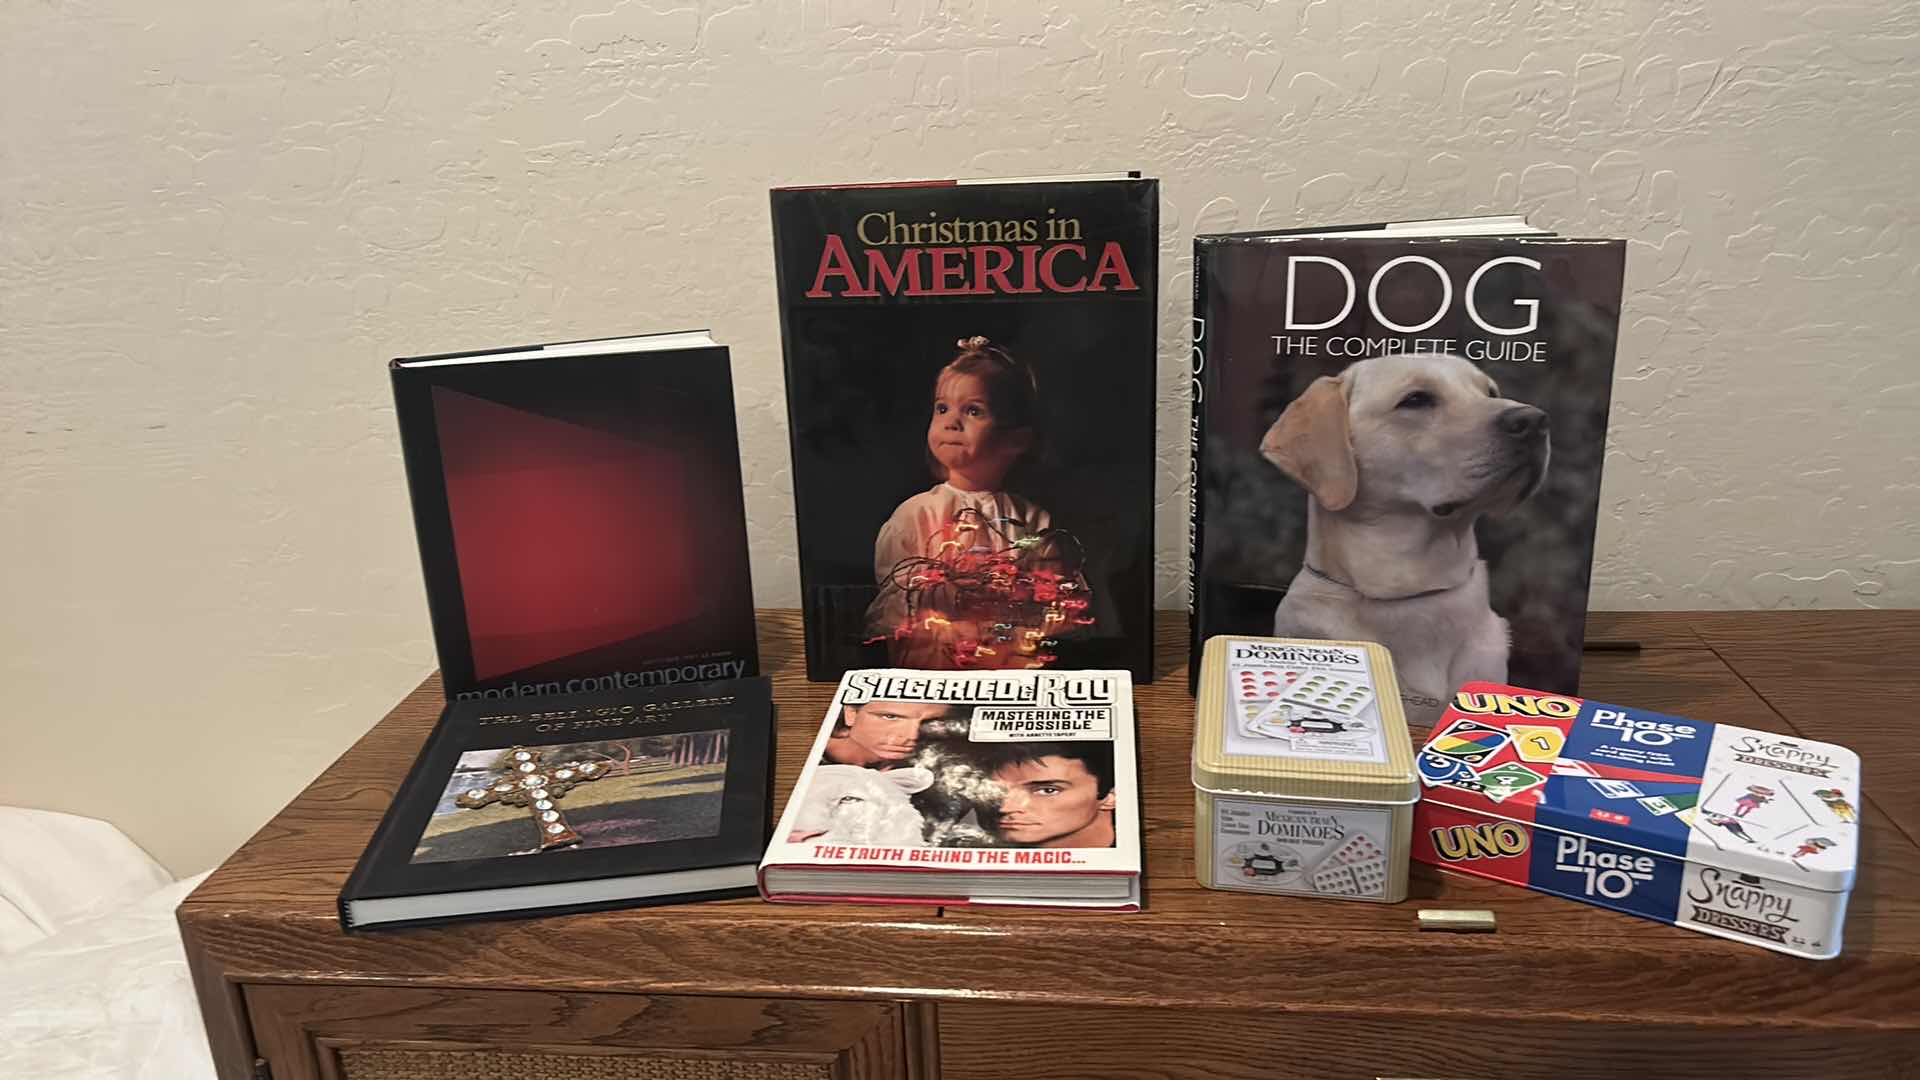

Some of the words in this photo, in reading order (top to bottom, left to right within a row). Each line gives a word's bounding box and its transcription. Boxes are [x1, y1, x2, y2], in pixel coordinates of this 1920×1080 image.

[856, 211, 1038, 246] Christmas
[1046, 208, 1082, 241] in
[805, 234, 1140, 298] AMERICA
[1285, 255, 1542, 336] DOG
[1271, 336, 1319, 356] THE
[1326, 337, 1457, 357] COMPLETE
[1465, 340, 1547, 362] GUIDE
[1236, 649, 1360, 665] DOMINOES
[1250, 644, 1302, 653] MEXICAN
[843, 672, 1020, 705] SIEGFRIED
[530, 705, 635, 723] BELLGIO
[981, 709, 1073, 721] MASTERING
[1076, 709, 1106, 720] THE
[1452, 692, 1582, 719] UNO
[535, 722, 566, 733] OF
[571, 718, 625, 730] FINE
[630, 713, 674, 725] ART
[993, 720, 1092, 731] IMPOSSIBLE
[1591, 709, 1697, 735] Phase
[1530, 736, 1550, 750] 1
[1620, 727, 1673, 746] 10
[1729, 736, 1841, 769] Snappy
[1257, 819, 1345, 841] DOMINOES
[1431, 821, 1530, 862] UNO
[814, 846, 845, 859] THE
[848, 848, 904, 861] TRUTH
[909, 849, 973, 863] BEHIND
[976, 850, 1009, 864] THE
[1014, 851, 1087, 865] MAGIC...
[1556, 835, 1656, 872] Phase
[1583, 867, 1634, 899] 10
[1687, 867, 1800, 923] Snappy
[1700, 908, 1784, 940] DRESSERS
